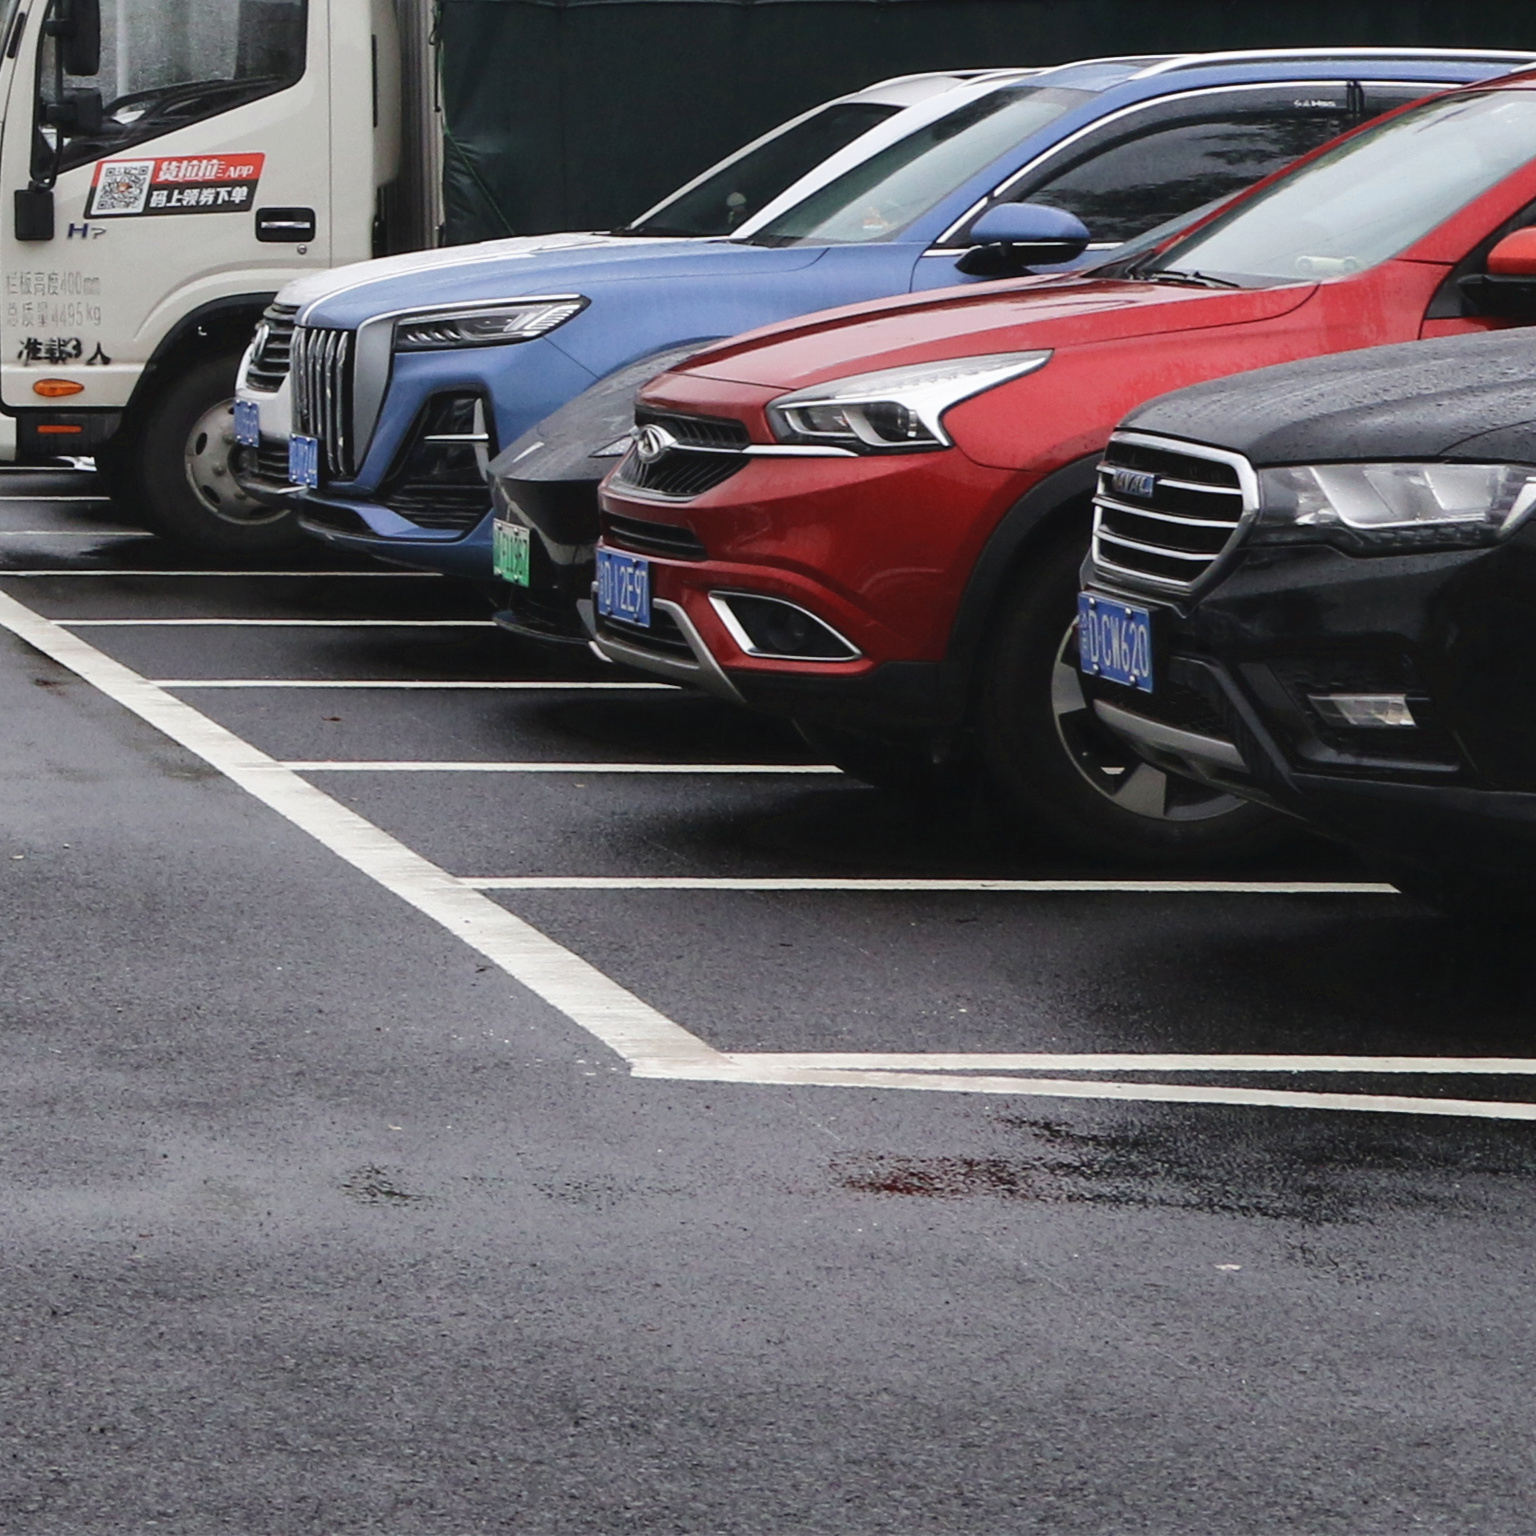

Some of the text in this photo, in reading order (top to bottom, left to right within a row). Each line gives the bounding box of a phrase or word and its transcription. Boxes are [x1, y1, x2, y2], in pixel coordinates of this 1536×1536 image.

[156, 158, 254, 182] 货拉拉 APP
[149, 186, 249, 208] 码上领券下单
